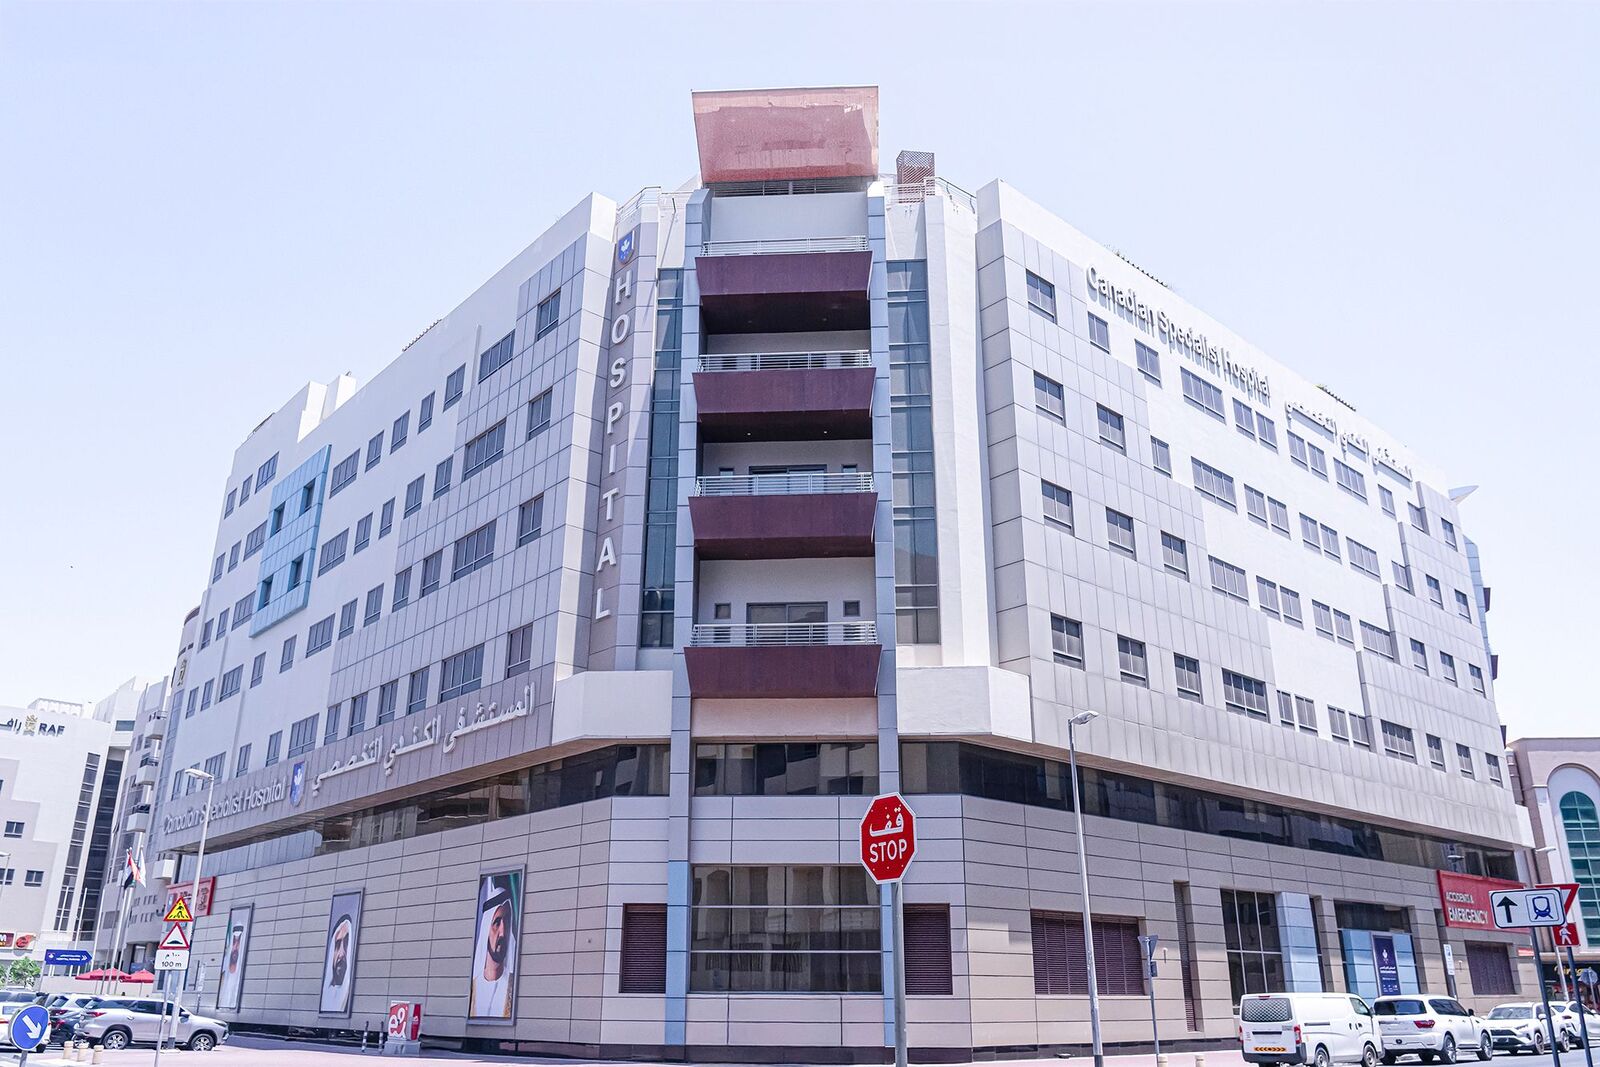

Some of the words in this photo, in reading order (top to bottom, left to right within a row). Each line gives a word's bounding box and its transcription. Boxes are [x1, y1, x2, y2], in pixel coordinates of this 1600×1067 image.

[1086, 265, 1155, 327] Canadian
[1157, 309, 1221, 369] Specialist
[595, 268, 632, 620] HOSPITAL
[39, 722, 65, 735] RAF
[443, 682, 535, 753] المستشفى
[312, 735, 383, 798] التخصصي
[384, 714, 442, 777] الكندي
[200, 794, 242, 823] Secialist
[243, 779, 286, 811] Hospital
[869, 807, 905, 837] قف
[869, 838, 908, 863] STOP
[1448, 907, 1489, 925] EMERGENCY
